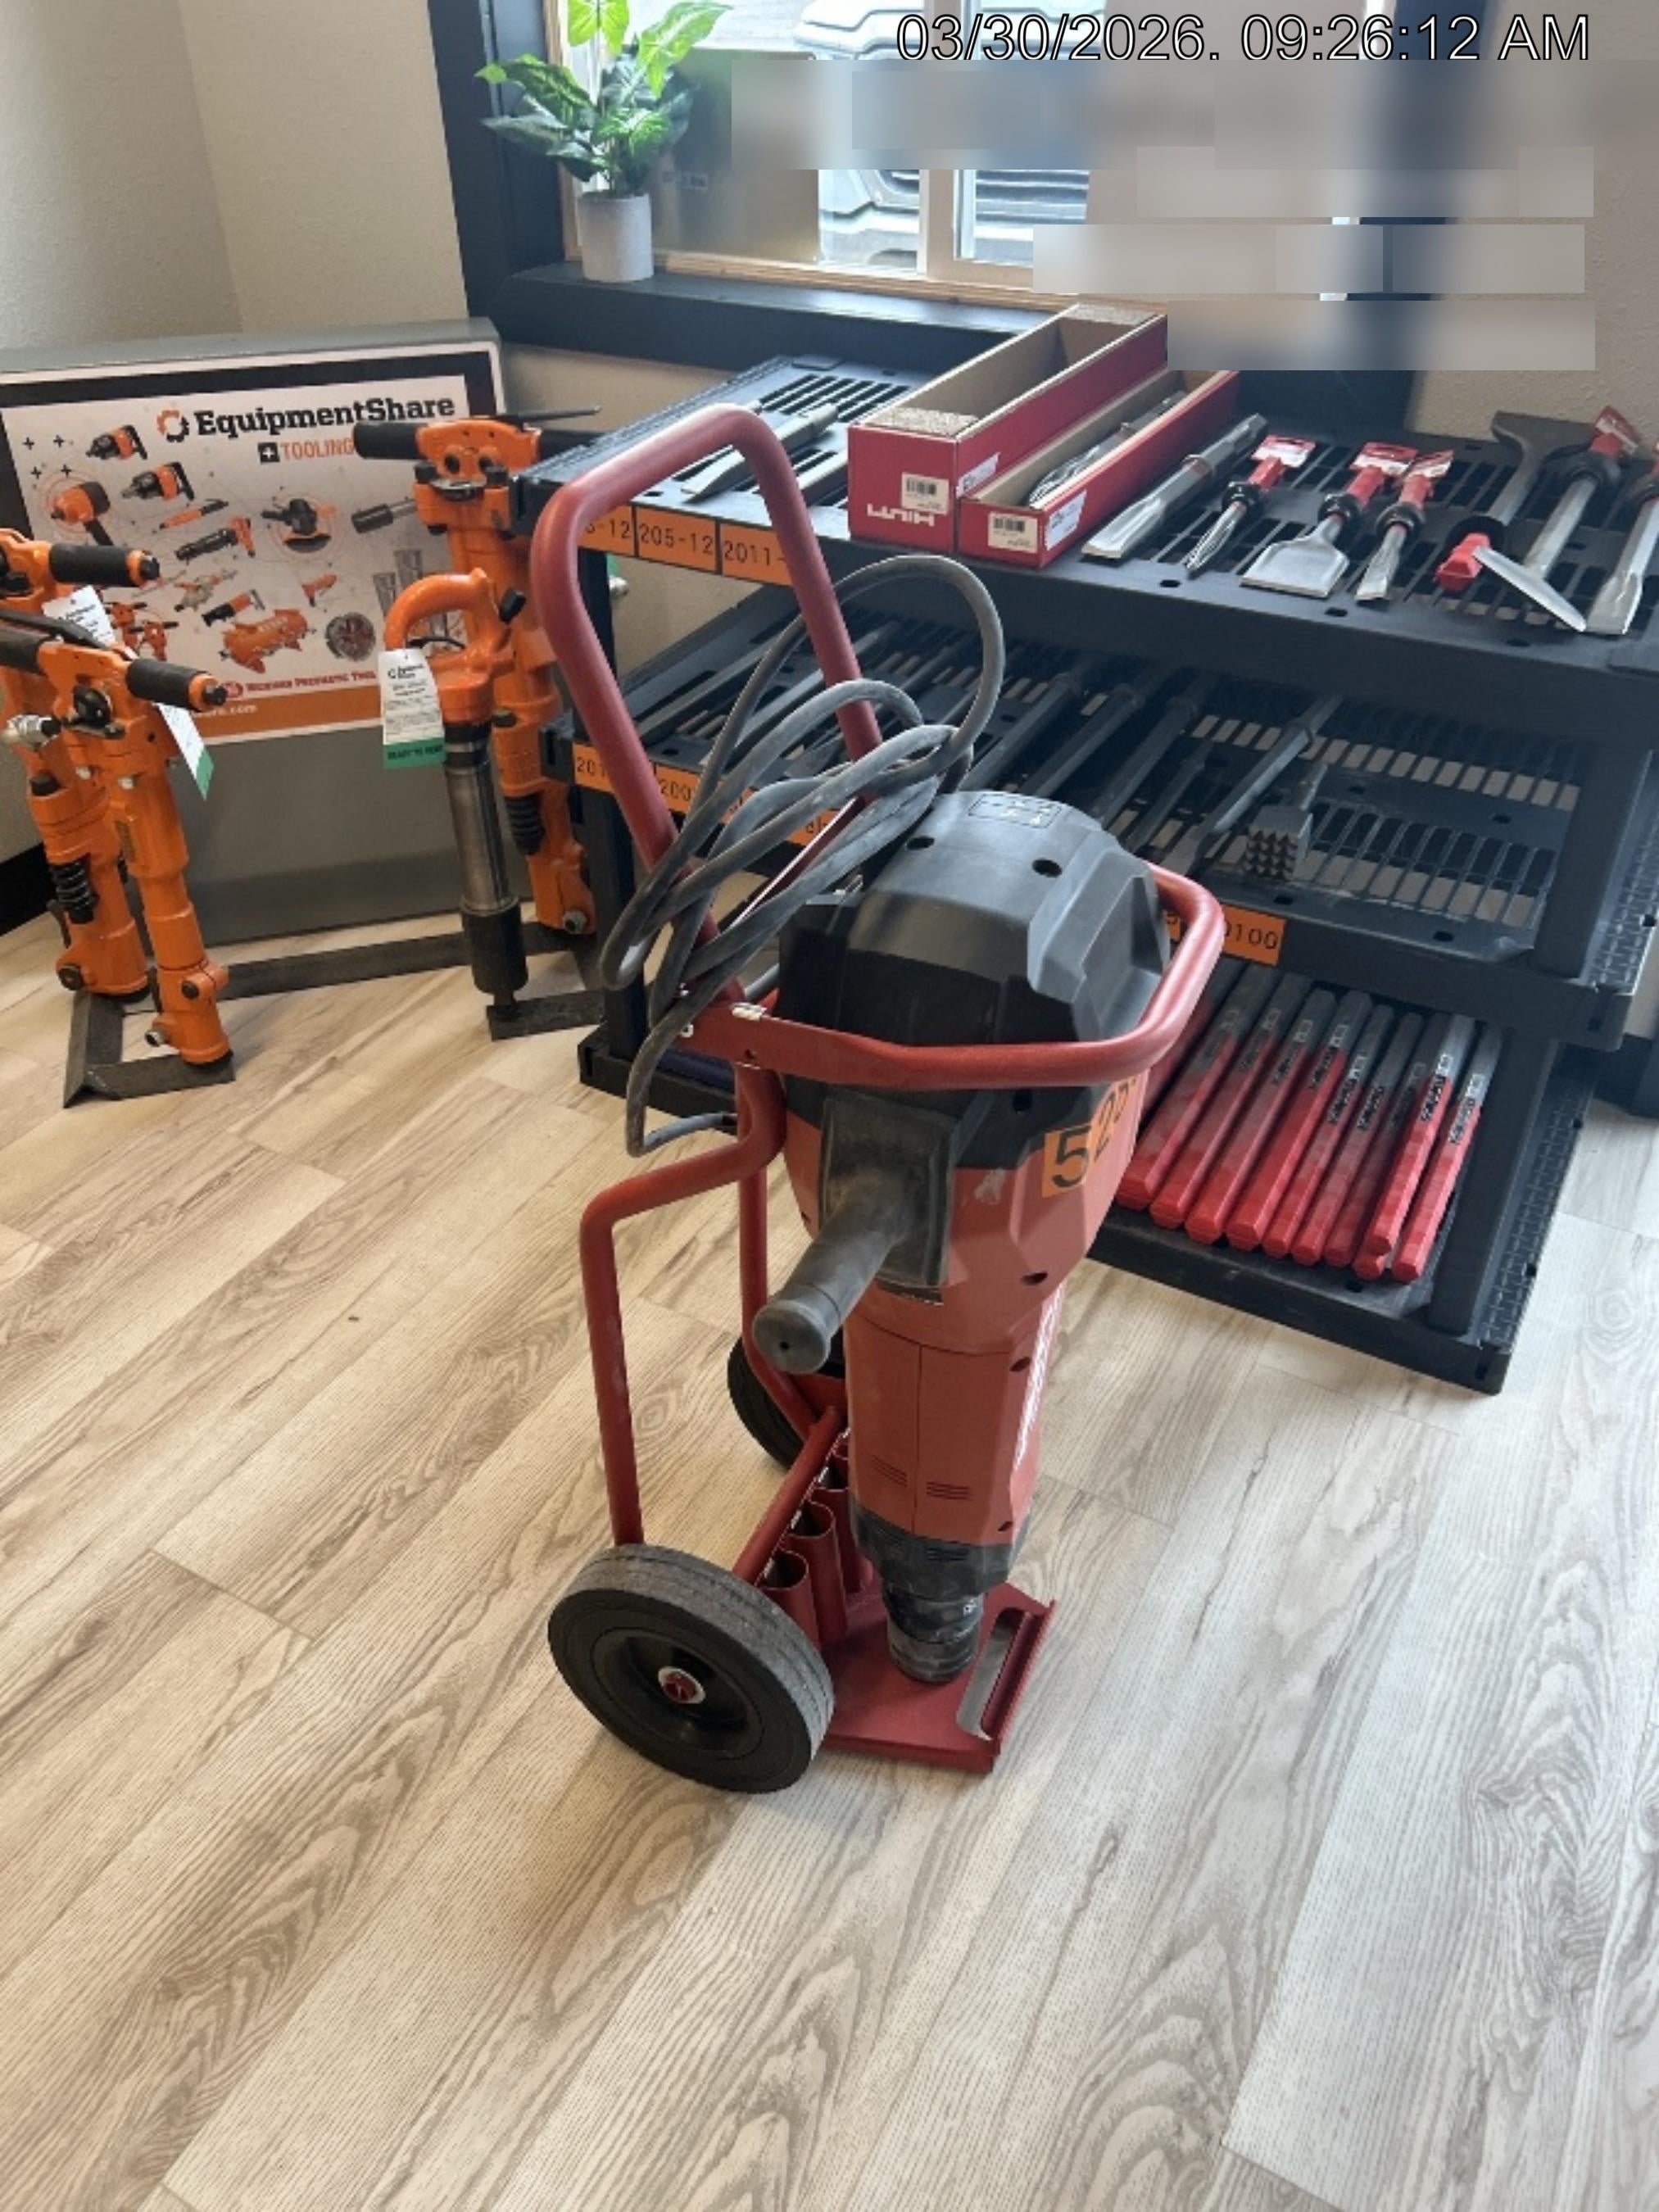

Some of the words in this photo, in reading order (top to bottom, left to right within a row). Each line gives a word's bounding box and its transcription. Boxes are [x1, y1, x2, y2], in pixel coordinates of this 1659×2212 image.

[195, 397, 455, 439] EquipmentShare
[280, 437, 355, 460] TOOLING
[639, 523, 714, 555] 205-12
[577, 756, 605, 777] 20
